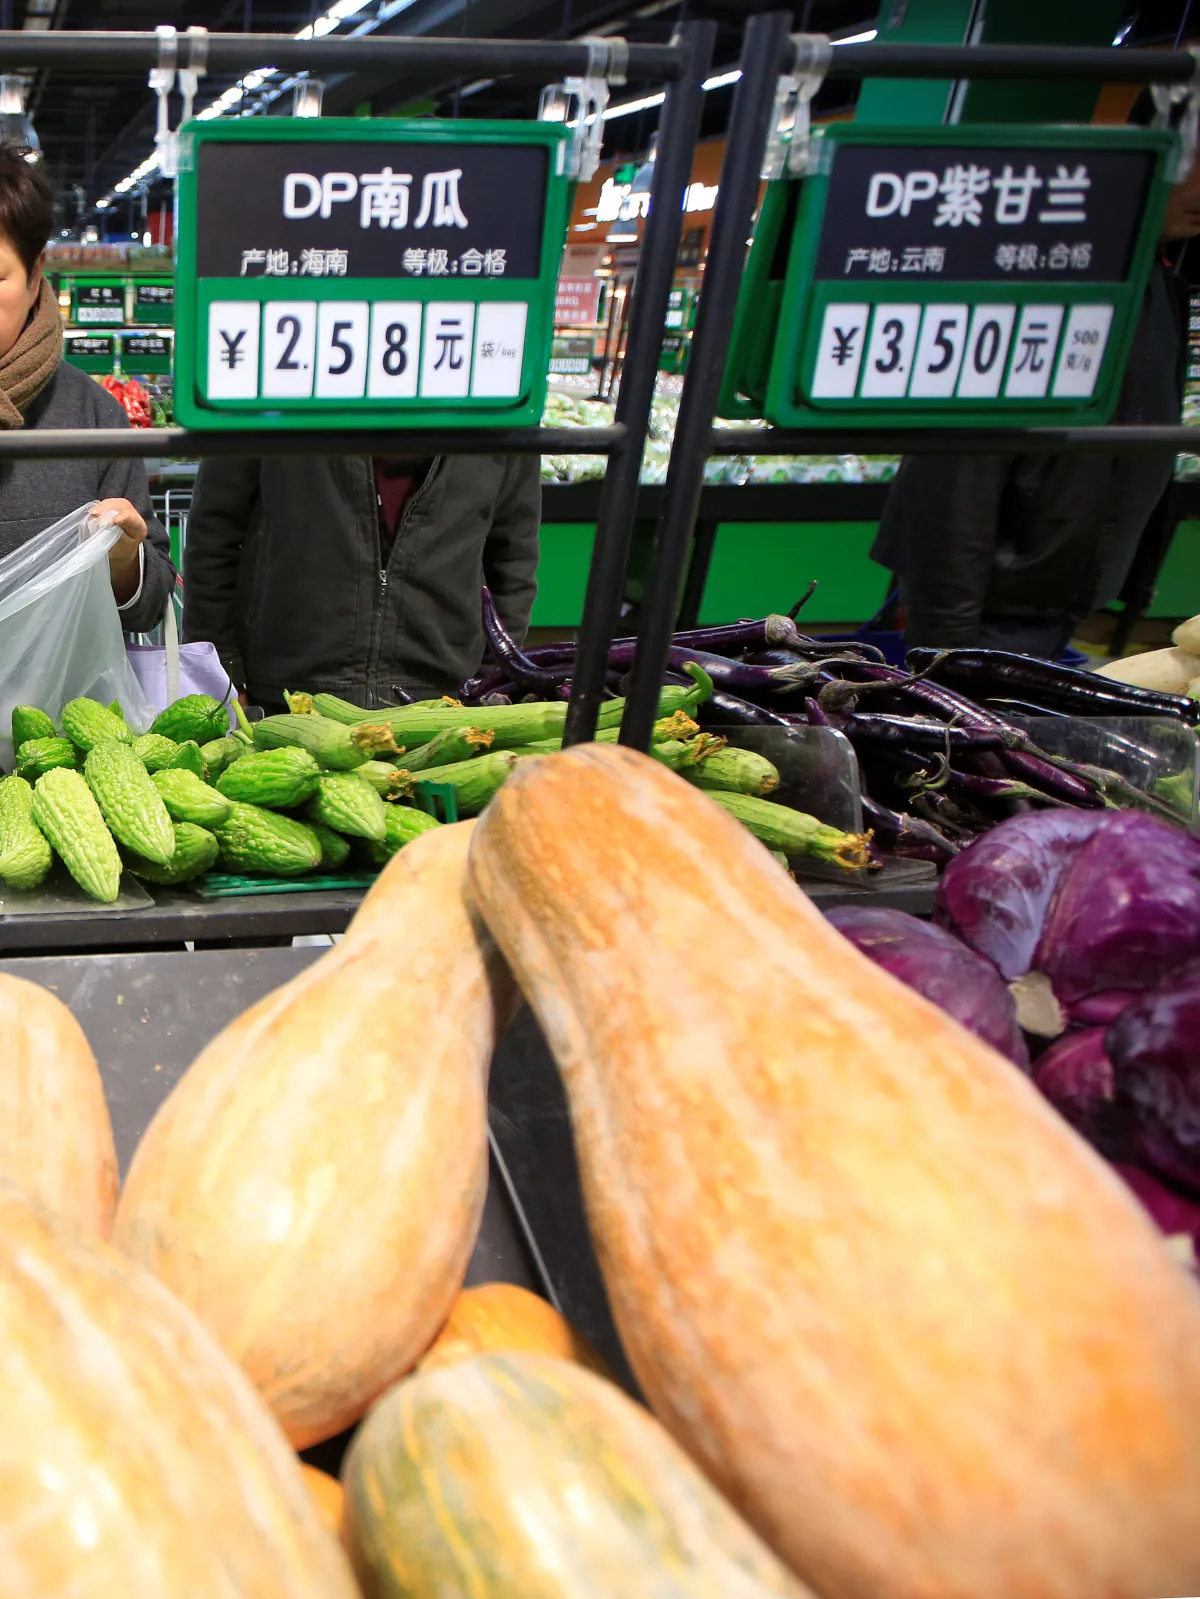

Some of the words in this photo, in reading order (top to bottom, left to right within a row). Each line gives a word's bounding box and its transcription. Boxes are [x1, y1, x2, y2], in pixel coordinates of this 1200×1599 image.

[282, 166, 468, 229] DP南瓜
[865, 161, 1091, 227] DP紫甘兰
[240, 247, 349, 277] 产地:海南
[402, 247, 507, 277] 等级:合格
[1071, 330, 1099, 344] 500
